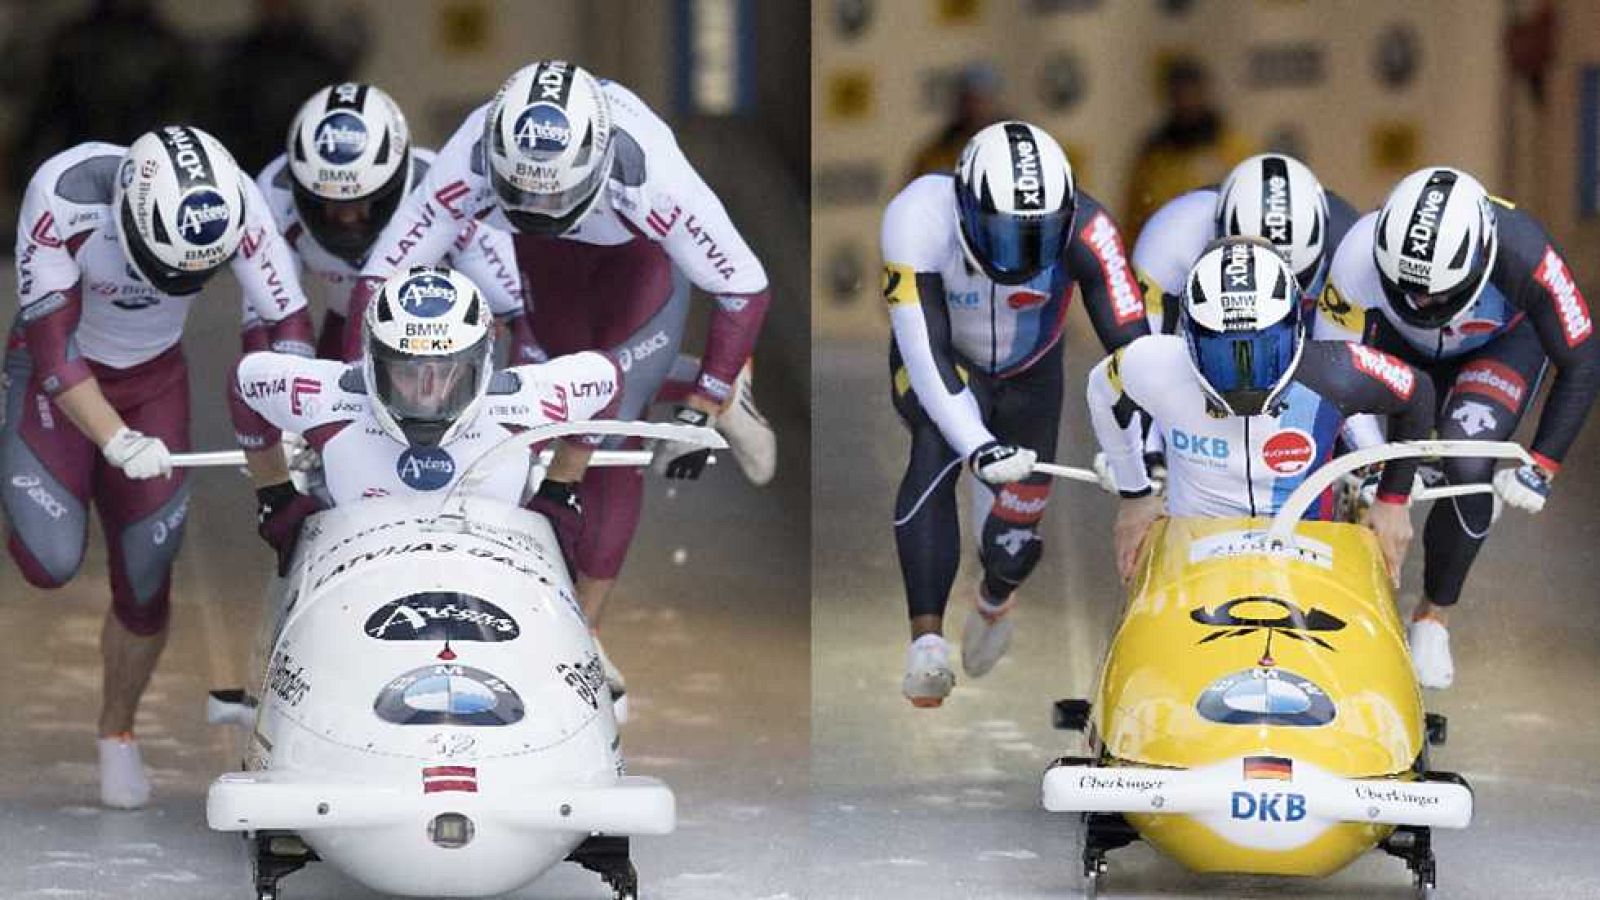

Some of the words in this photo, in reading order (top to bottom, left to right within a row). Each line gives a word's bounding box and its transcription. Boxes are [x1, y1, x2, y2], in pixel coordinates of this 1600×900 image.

[319, 169, 358, 181] BMW
[516, 162, 558, 178] BMW
[1016, 140, 1040, 204] xDrive
[1265, 176, 1288, 240] xDrive
[1409, 190, 1444, 255] xDrive
[685, 215, 736, 280] LATVIA
[406, 323, 449, 336] BMW
[633, 331, 669, 360] asics
[1171, 428, 1229, 459] DKB
[1230, 790, 1307, 822] DKB
